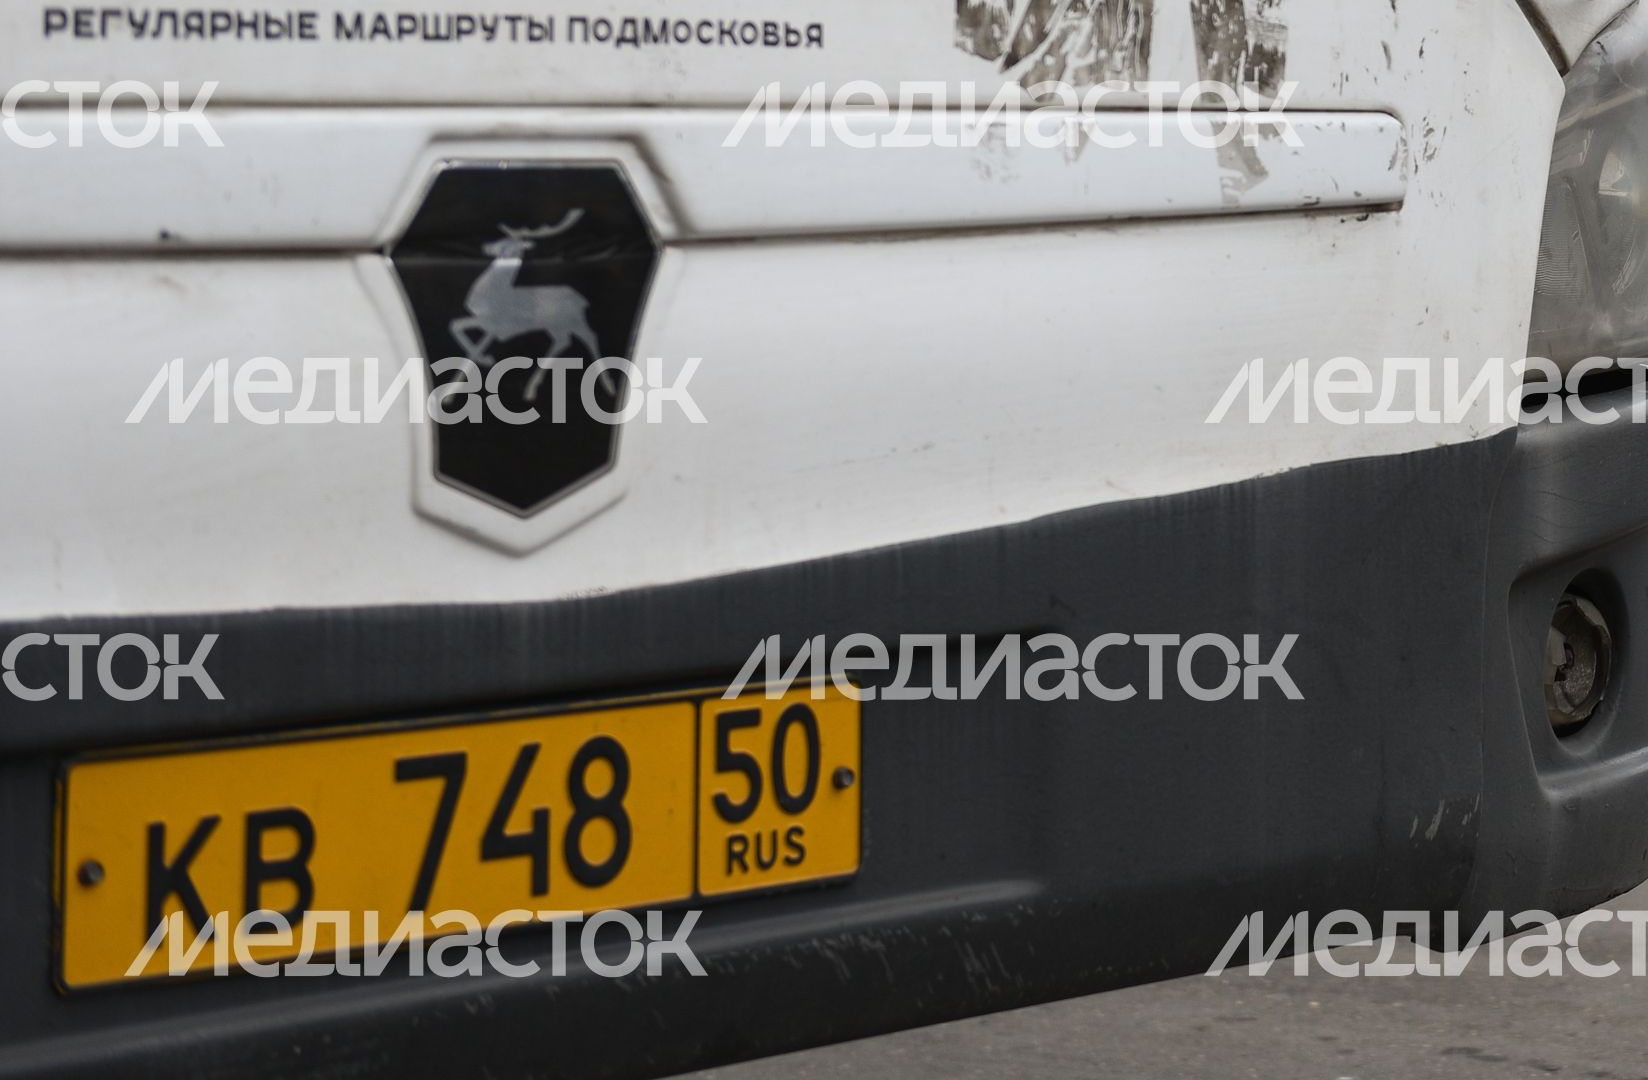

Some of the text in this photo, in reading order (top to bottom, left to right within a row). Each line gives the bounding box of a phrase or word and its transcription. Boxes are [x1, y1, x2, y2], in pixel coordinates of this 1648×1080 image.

[43, 7, 825, 49] РЕГУЛЯРНЫЕ МАРШРУТЫ ПОДМОСКОВЬЯ
[145, 702, 821, 952] КВ 748 50
[725, 825, 808, 878] RUS
